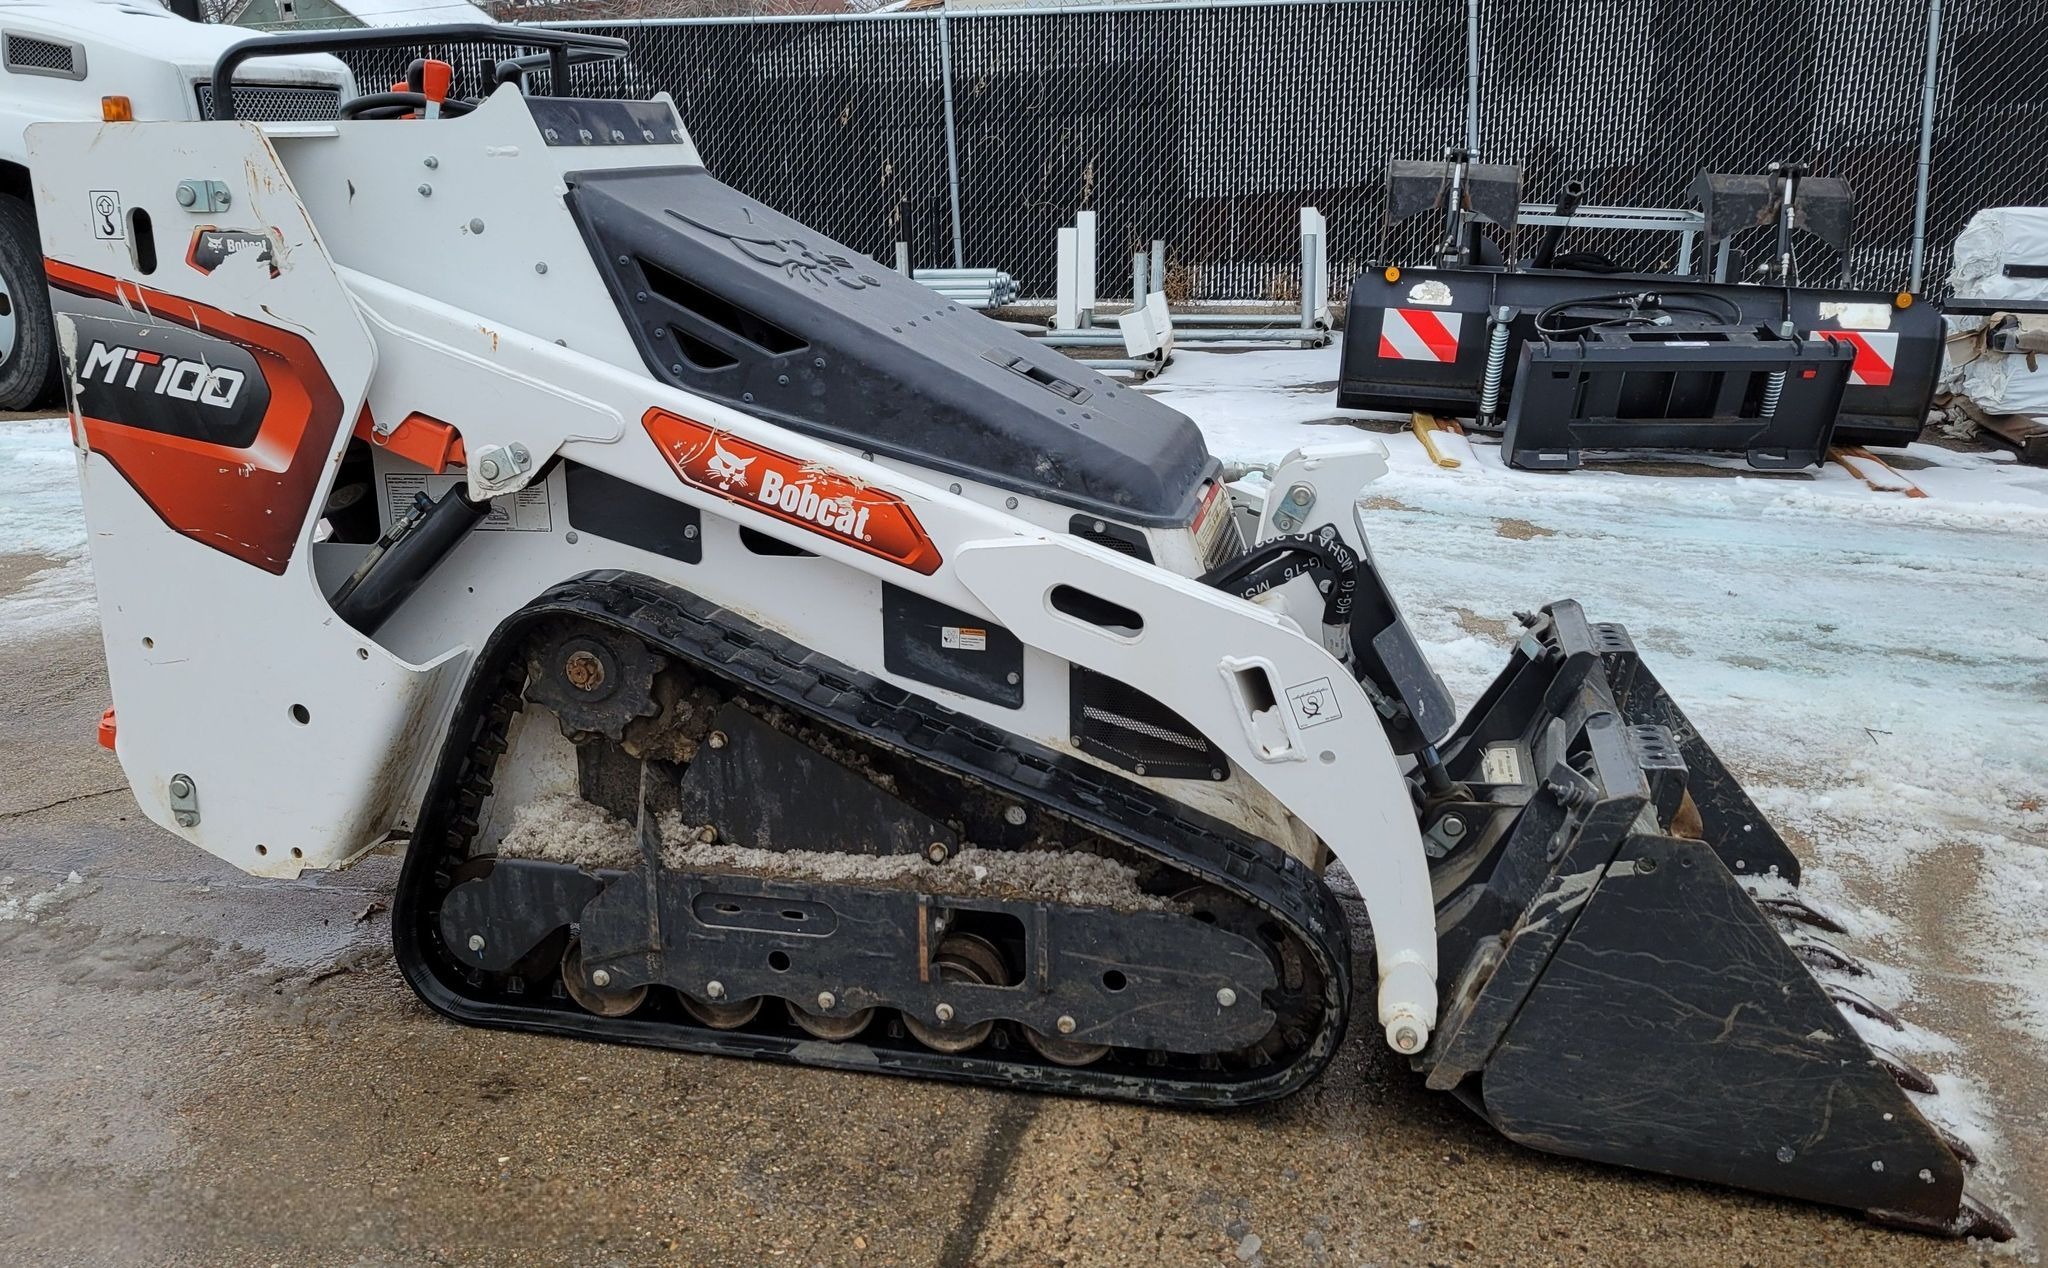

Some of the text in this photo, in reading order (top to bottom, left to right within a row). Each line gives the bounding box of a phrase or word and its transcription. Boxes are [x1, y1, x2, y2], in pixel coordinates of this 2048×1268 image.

[81, 342, 245, 408] MT100
[1319, 534, 1354, 572] MSHA
[1336, 580, 1355, 614] HG-16
